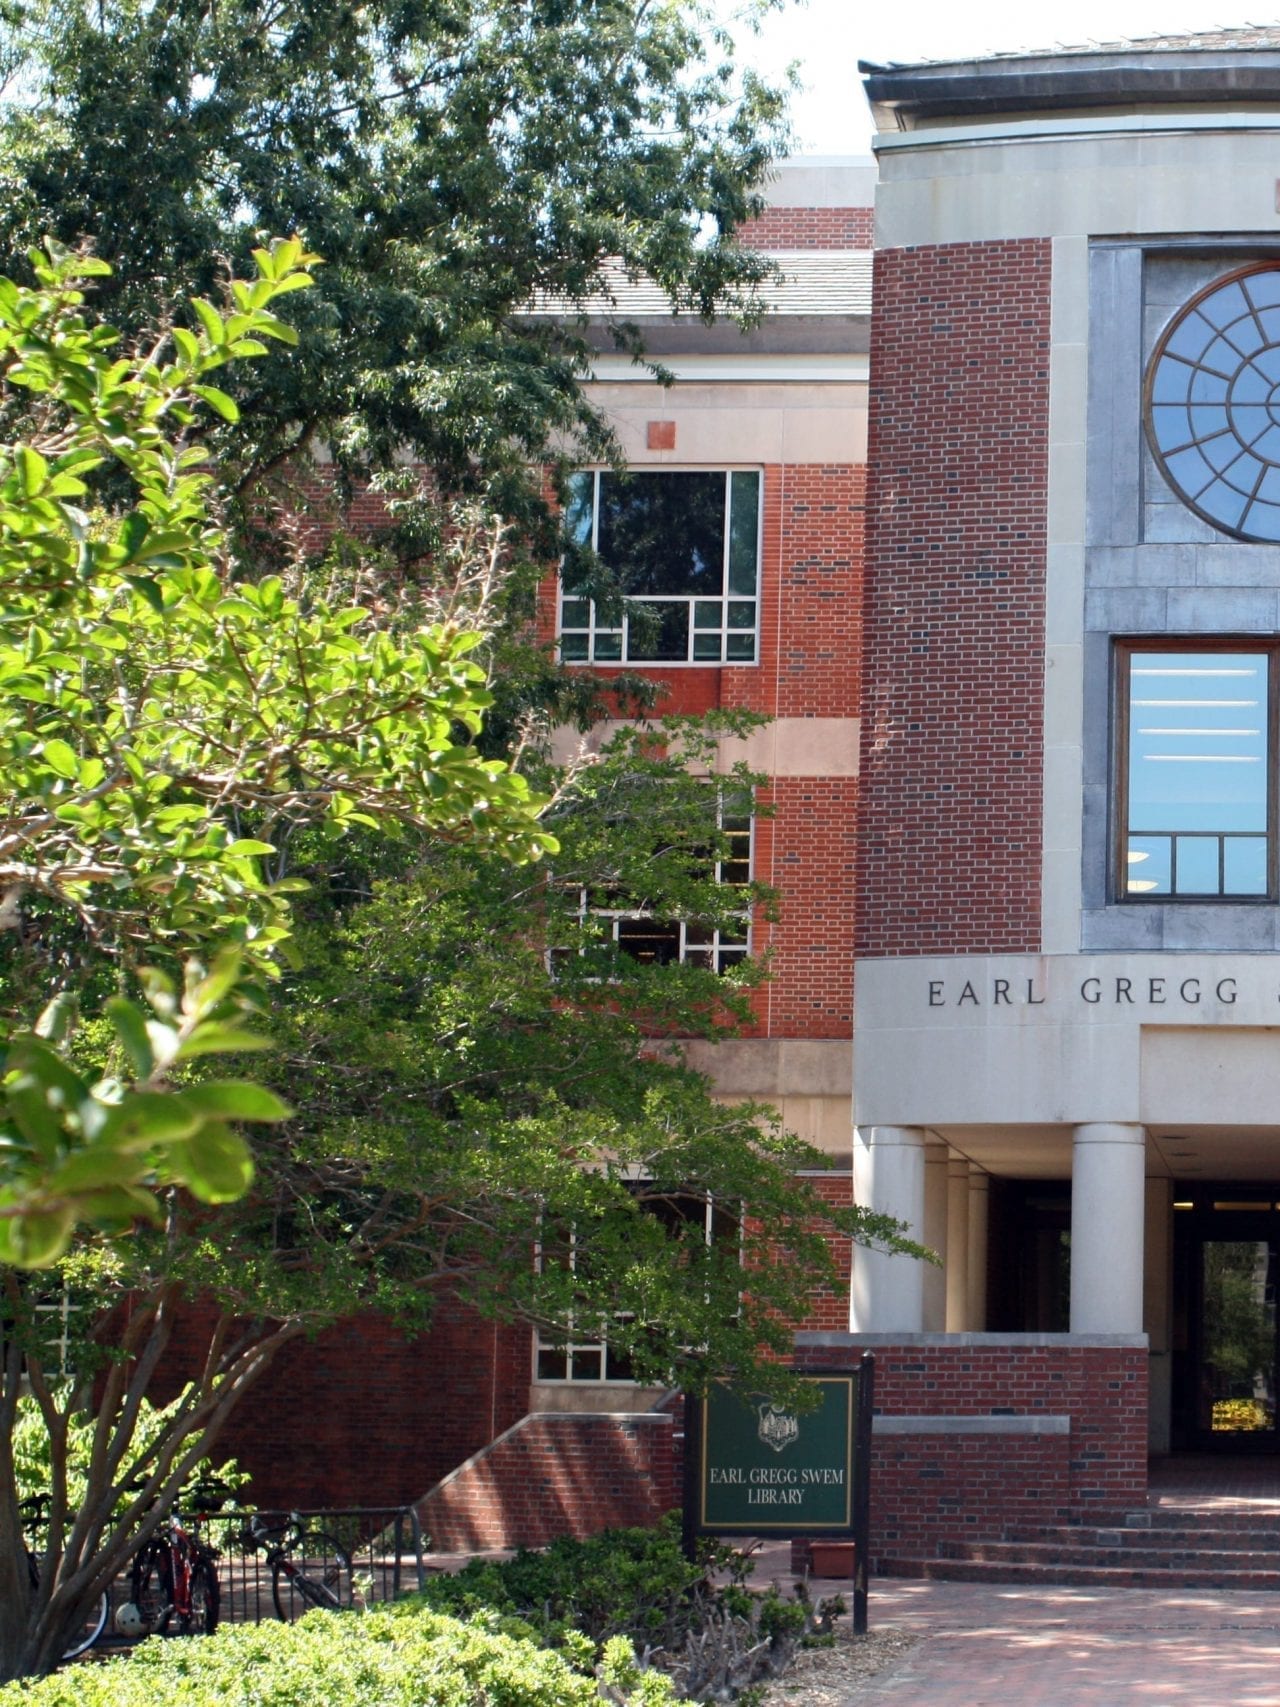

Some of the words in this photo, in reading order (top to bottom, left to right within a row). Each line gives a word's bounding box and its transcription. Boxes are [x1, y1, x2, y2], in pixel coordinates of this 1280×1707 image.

[928, 978, 1046, 1006] EARL
[1080, 976, 1238, 1006] GREGG
[710, 1468, 747, 1484] EARL
[749, 1468, 797, 1484] GREGG
[801, 1468, 844, 1485] SWEM
[748, 1488, 805, 1504] LIBRARY
